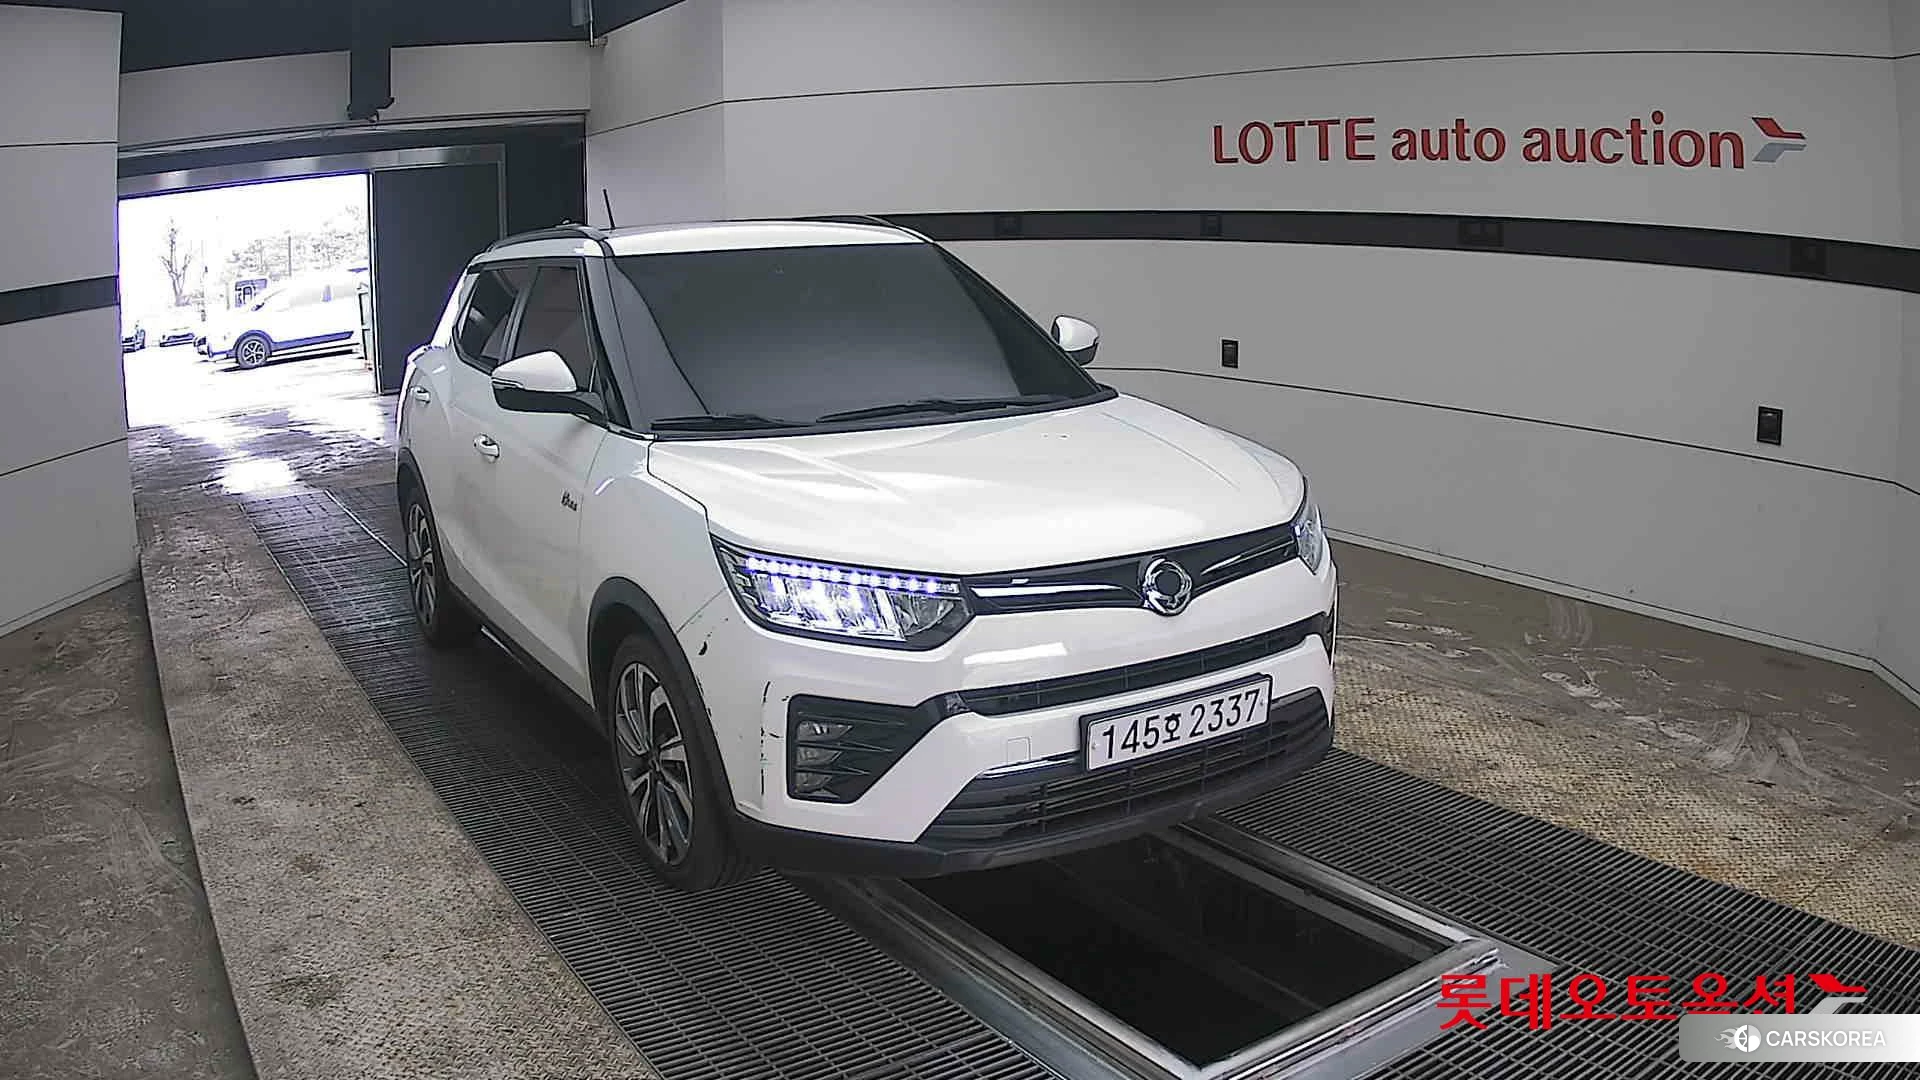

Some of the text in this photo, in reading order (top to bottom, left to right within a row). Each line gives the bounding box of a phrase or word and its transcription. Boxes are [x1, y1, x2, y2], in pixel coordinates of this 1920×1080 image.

[1212, 110, 1746, 170] LOTTE auto auction
[1102, 687, 1262, 760] 145호 2337
